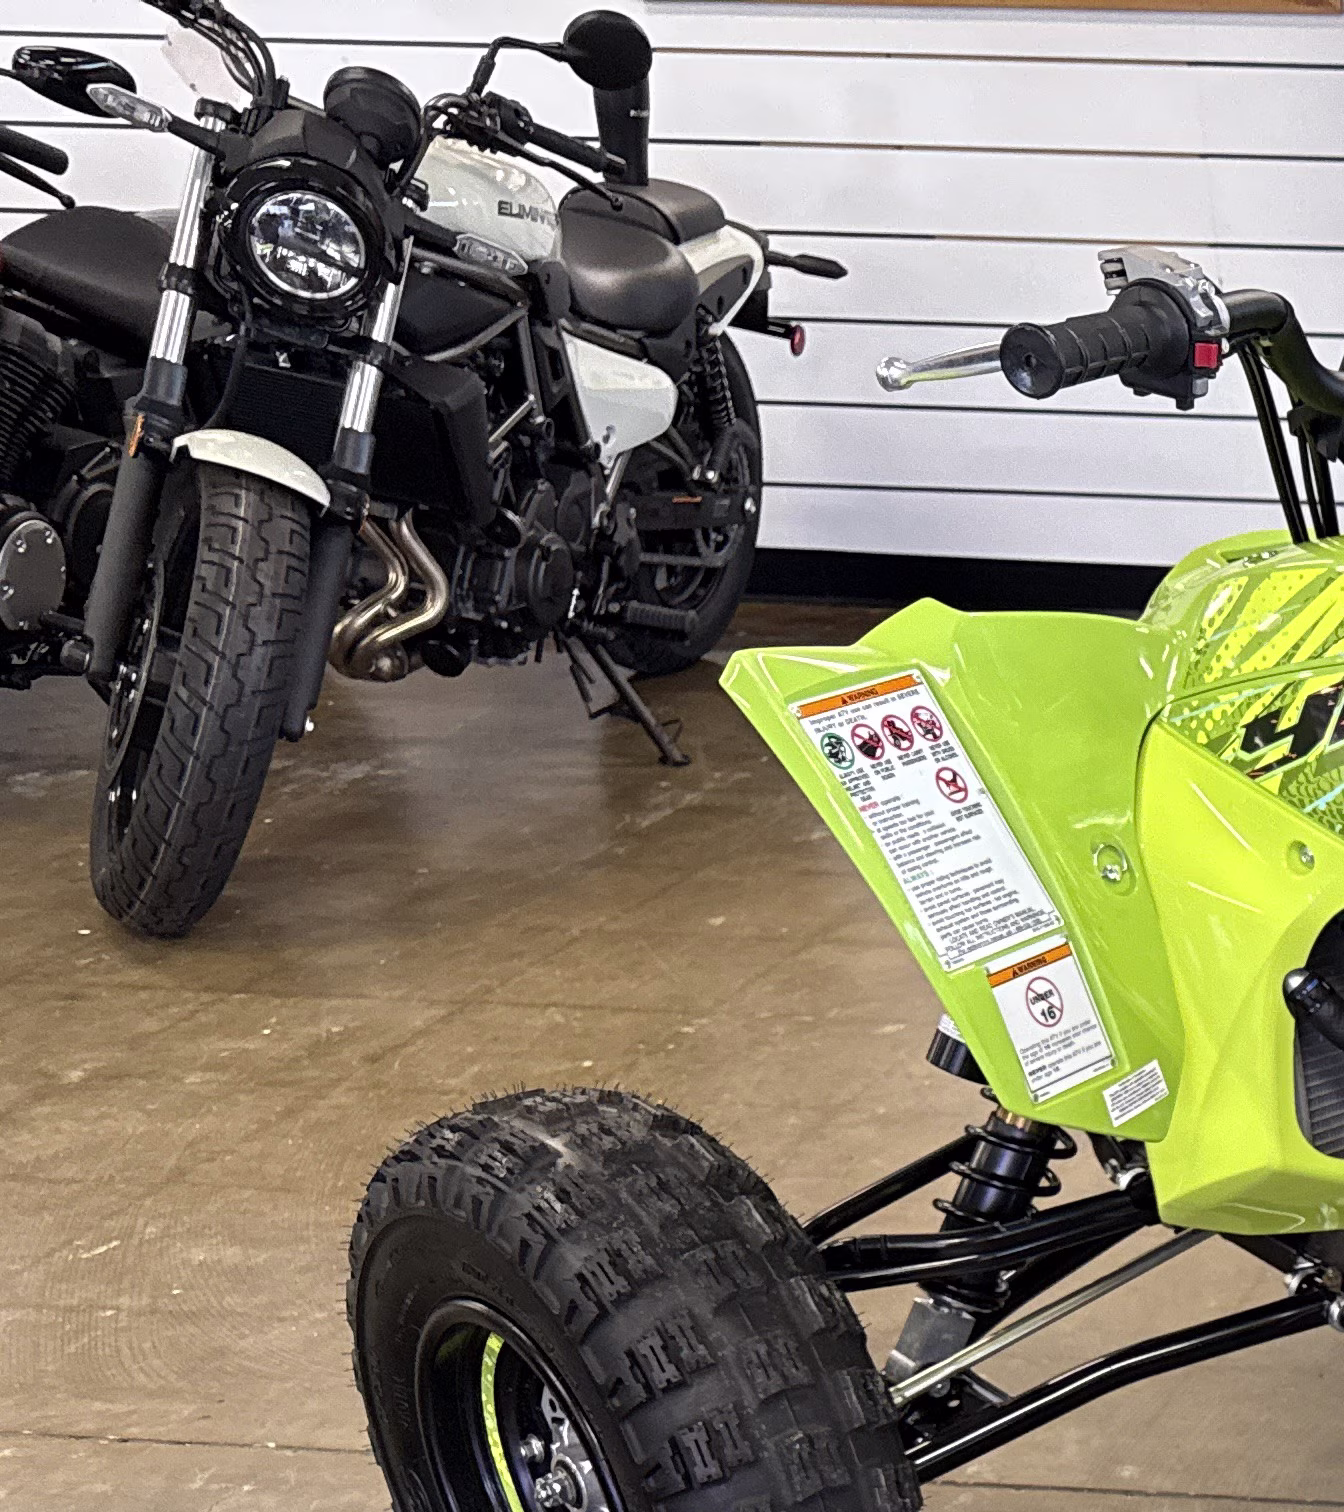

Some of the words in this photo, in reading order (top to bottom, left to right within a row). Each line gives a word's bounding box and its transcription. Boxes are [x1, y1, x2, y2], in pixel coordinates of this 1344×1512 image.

[847, 688, 879, 701] WARNING
[1030, 990, 1054, 1005] UNDER
[1041, 1004, 1056, 1022] 16
